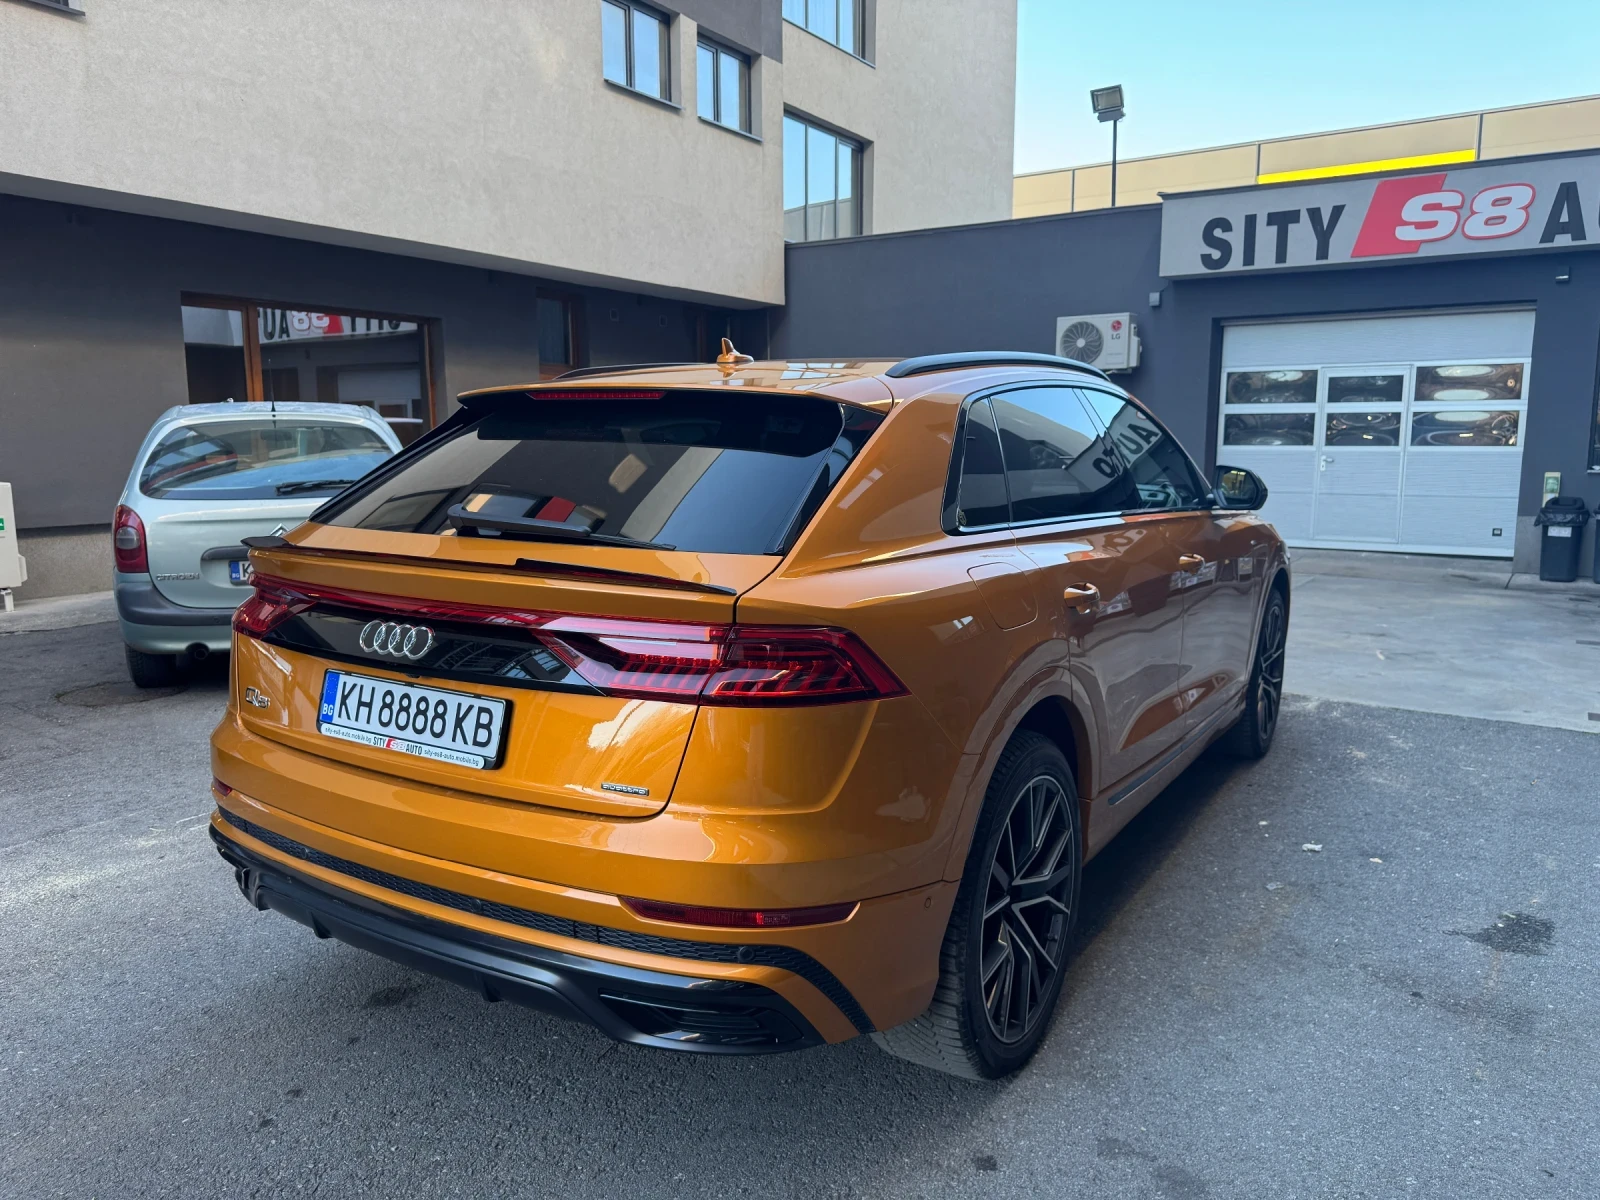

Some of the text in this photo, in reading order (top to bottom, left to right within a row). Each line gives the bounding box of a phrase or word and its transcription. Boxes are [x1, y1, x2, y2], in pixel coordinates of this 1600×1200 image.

[1200, 181, 1600, 271] SITY S8 A
[245, 686, 271, 709] Q8
[322, 703, 334, 716] BG
[372, 736, 386, 748] SITY
[405, 743, 423, 756] AUTO
[602, 783, 647, 795] quattro
